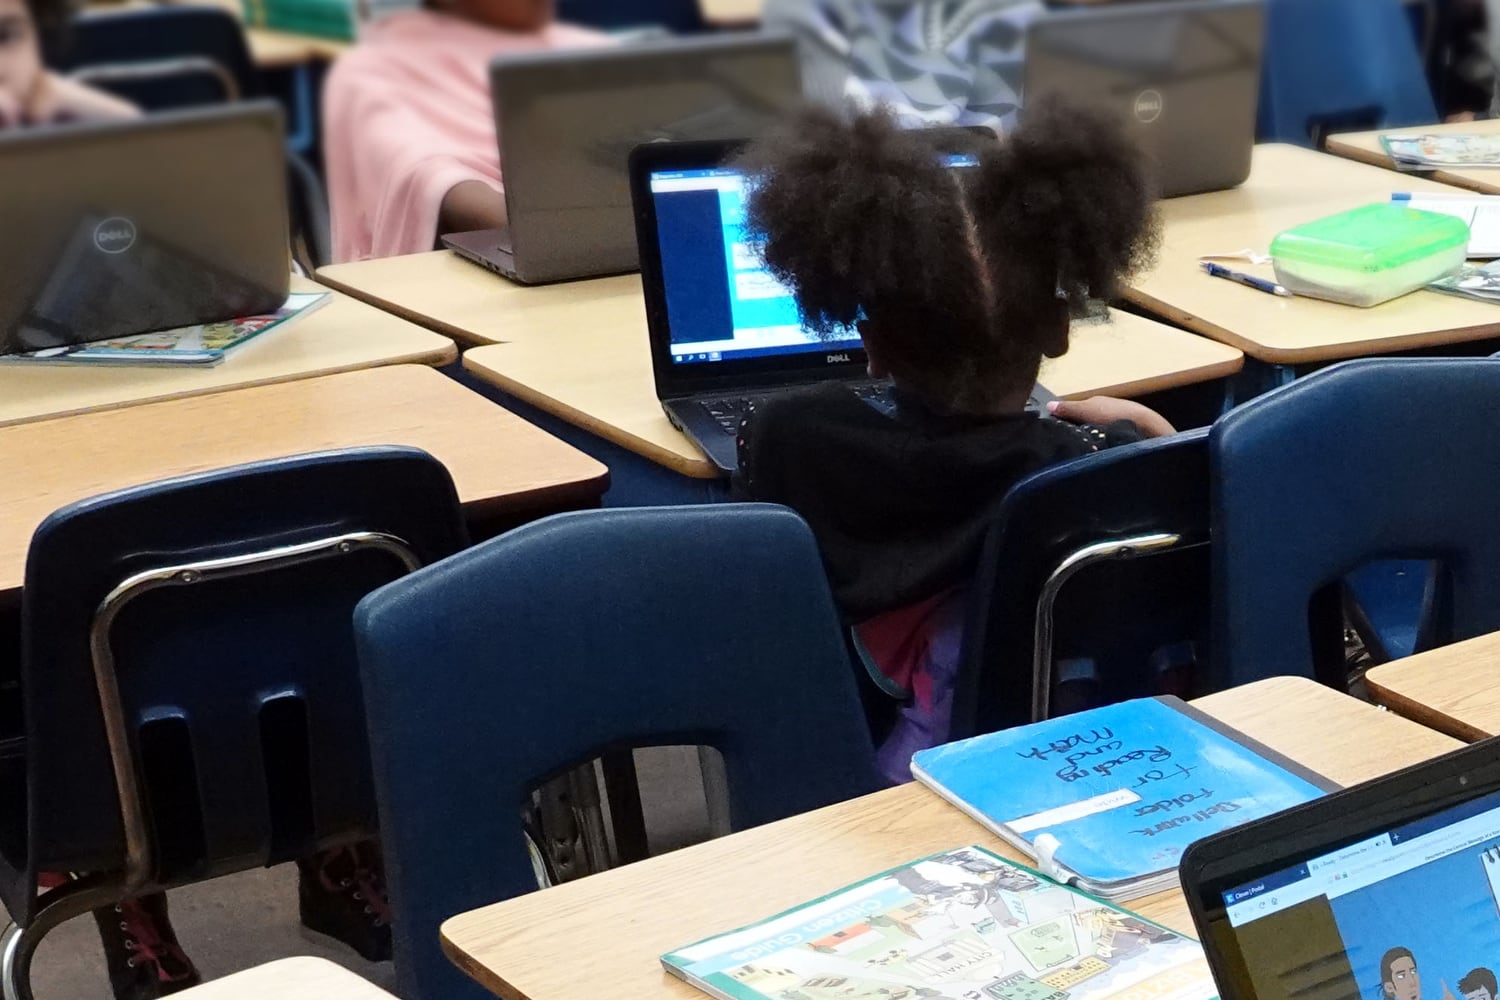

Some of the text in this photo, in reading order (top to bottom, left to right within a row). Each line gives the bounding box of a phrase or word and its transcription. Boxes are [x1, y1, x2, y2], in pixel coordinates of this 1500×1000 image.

[826, 352, 851, 363] DELL
[1055, 745, 1173, 783] Reading
[1064, 740, 1124, 768] and
[730, 898, 884, 962] Citizen Guide
